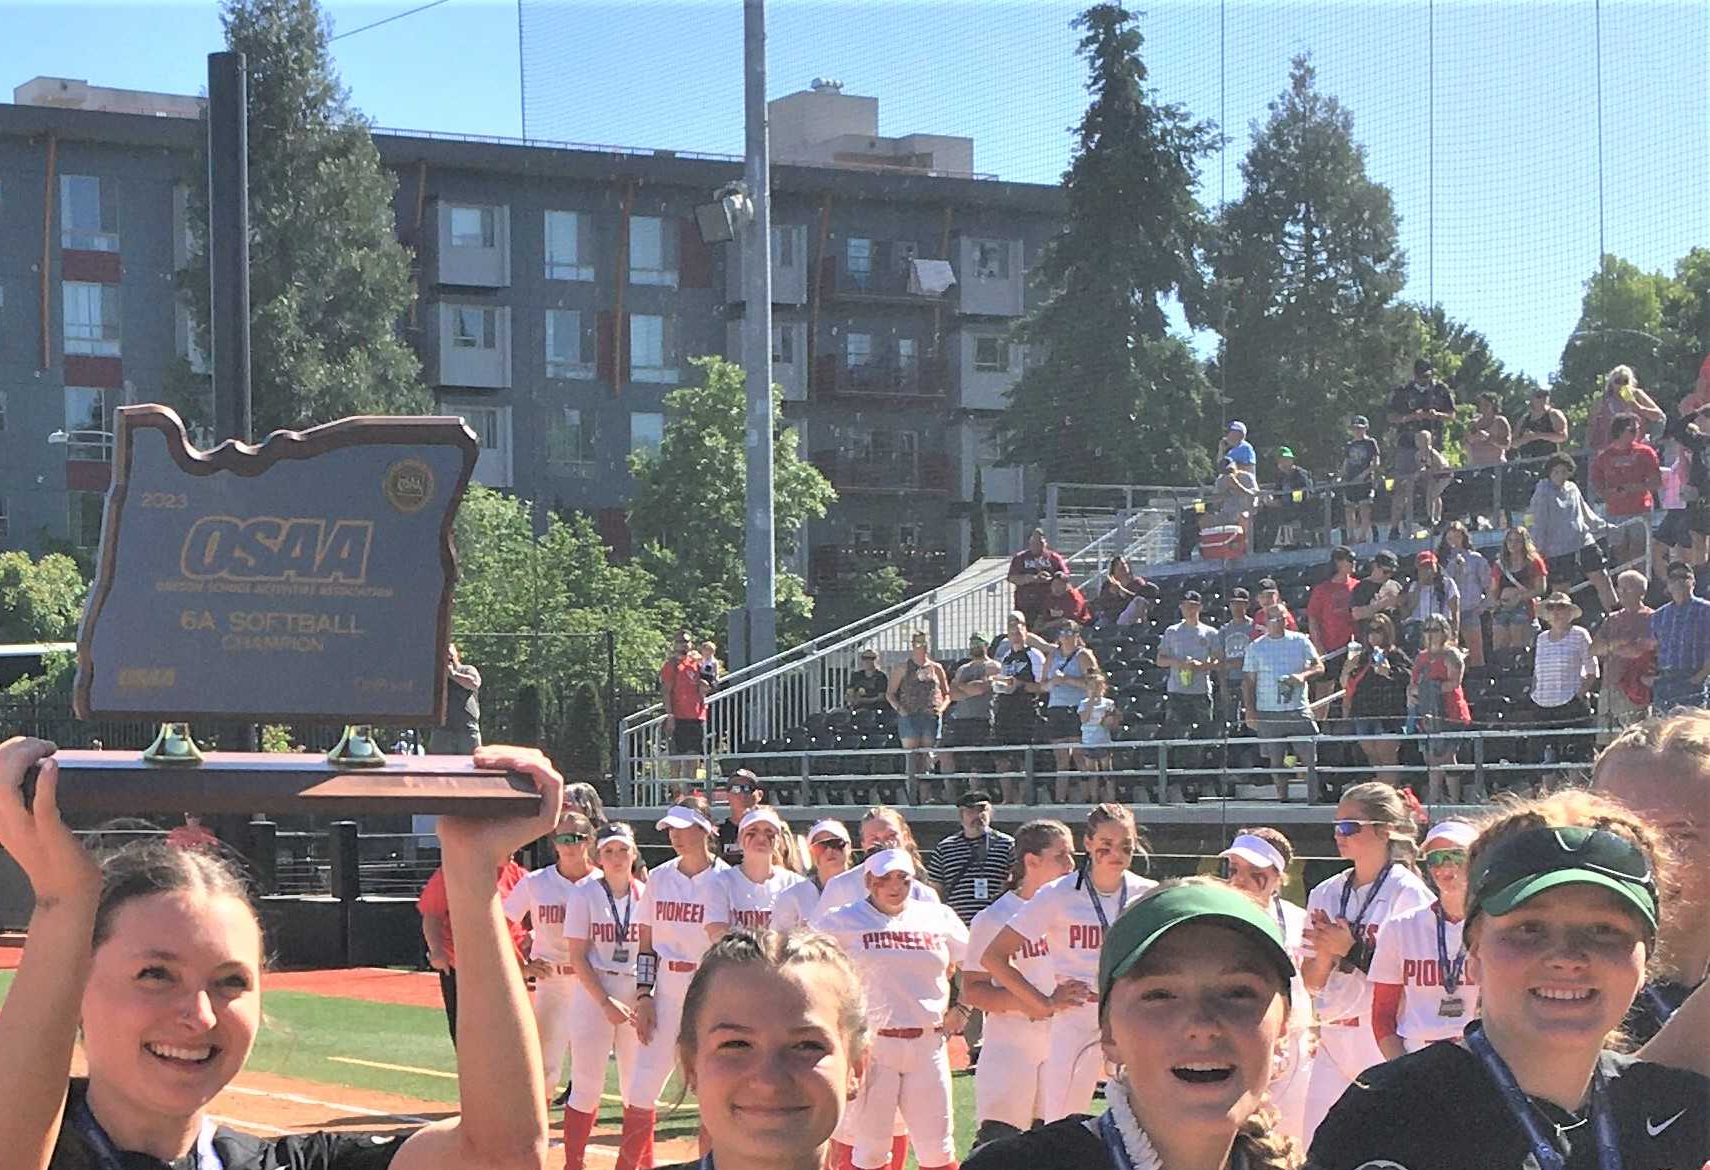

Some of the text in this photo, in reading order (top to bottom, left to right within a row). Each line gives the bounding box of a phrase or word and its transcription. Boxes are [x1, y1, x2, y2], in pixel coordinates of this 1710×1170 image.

[180, 515, 374, 584] OSAA
[180, 609, 364, 634] 6A SOFTBALL
[221, 634, 324, 652] CHAMPION
[592, 922, 640, 943] PIOEE
